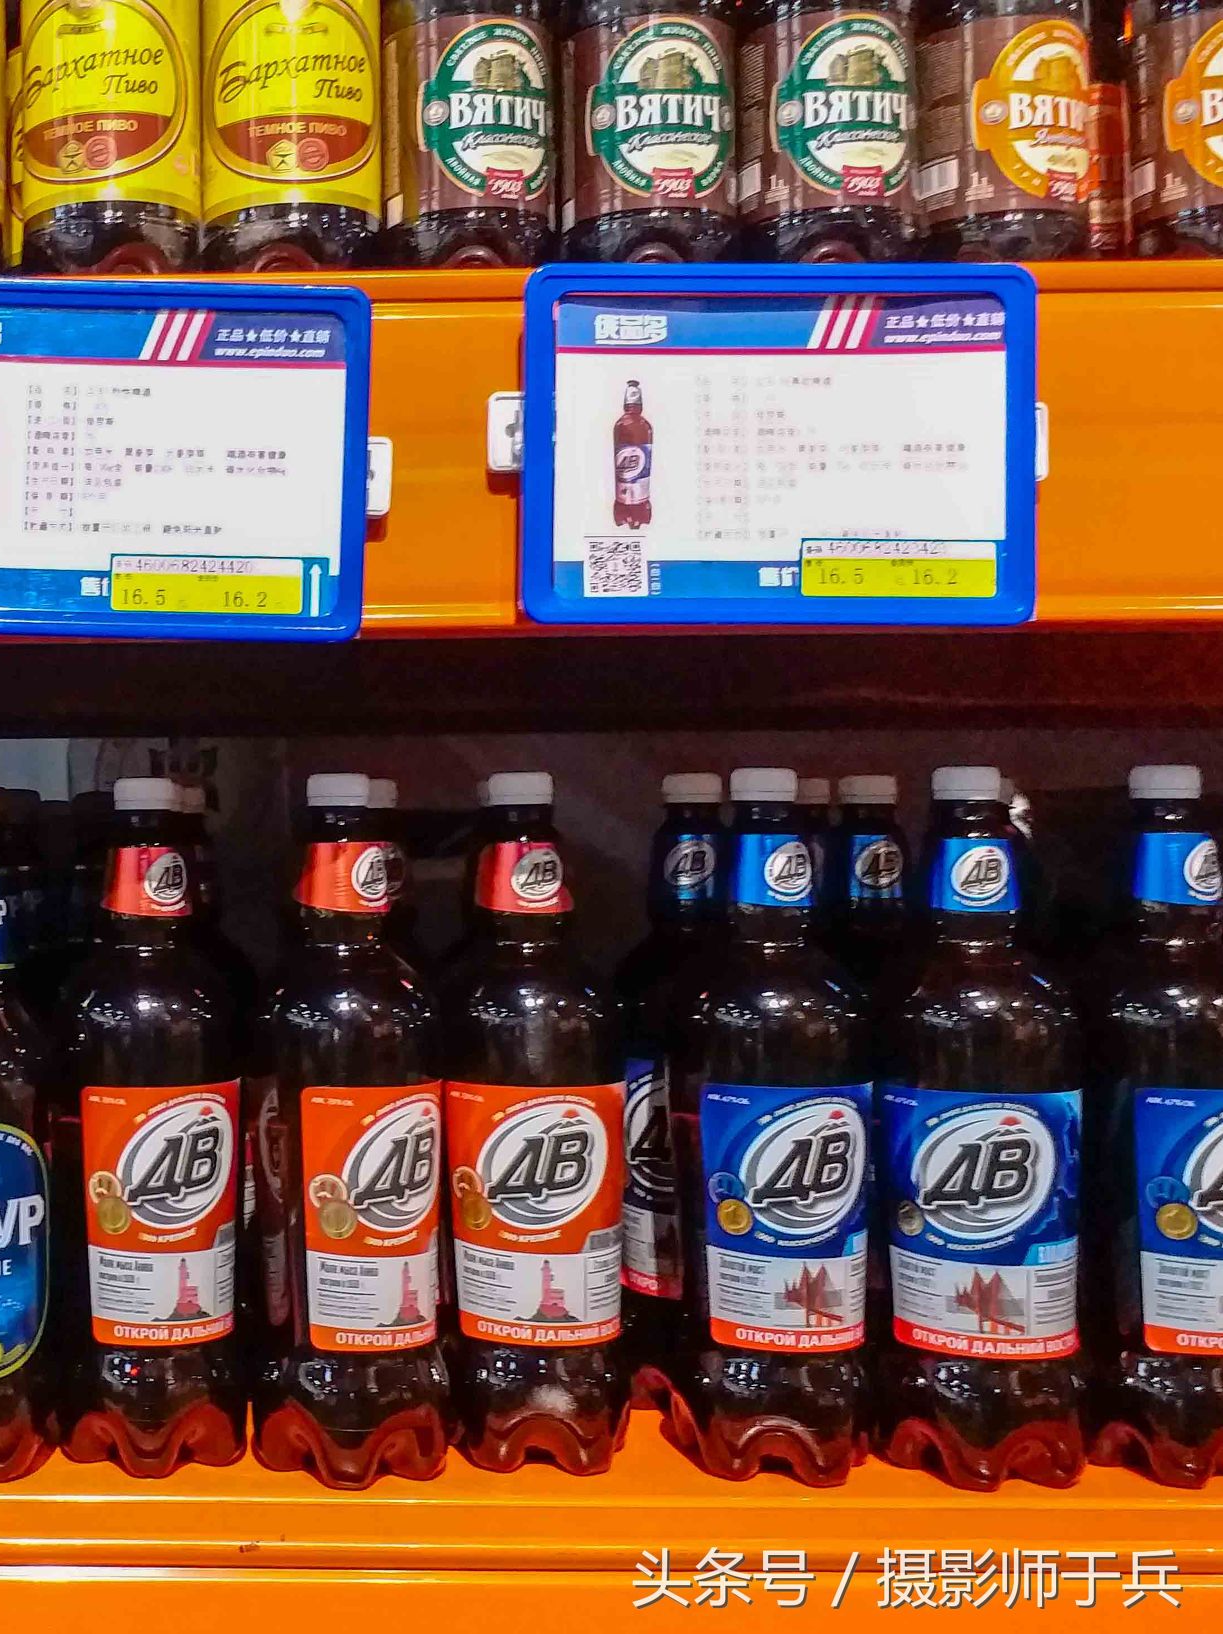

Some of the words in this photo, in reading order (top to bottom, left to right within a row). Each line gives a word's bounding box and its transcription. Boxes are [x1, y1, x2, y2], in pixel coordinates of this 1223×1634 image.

[449, 93, 546, 137] ВЯТИЧ
[615, 95, 721, 132] ВЯТИЧ
[802, 91, 907, 131] ВЯТИЧ
[1009, 93, 1088, 131] ВЯТИ
[818, 567, 864, 585] 16.5
[912, 567, 958, 585] 16.2
[121, 588, 166, 606] 16.5
[223, 591, 268, 608] 16.2
[127, 1126, 223, 1205] ДВ
[487, 1129, 593, 1203] ДВ
[749, 1130, 855, 1207] ДВ
[920, 1137, 1034, 1210] ДВ
[114, 1325, 168, 1341] ОТКРОЙ
[336, 1331, 392, 1346] ОТКРОЙ
[477, 1320, 532, 1341] ОТКРОЙ
[534, 1322, 599, 1343] ДАЛЬНИЙ
[736, 1327, 796, 1347] ОТКРОЙ
[912, 1328, 969, 1350] ОТКРОЙ
[971, 1337, 1045, 1355] ДАЛЬНИЙ
